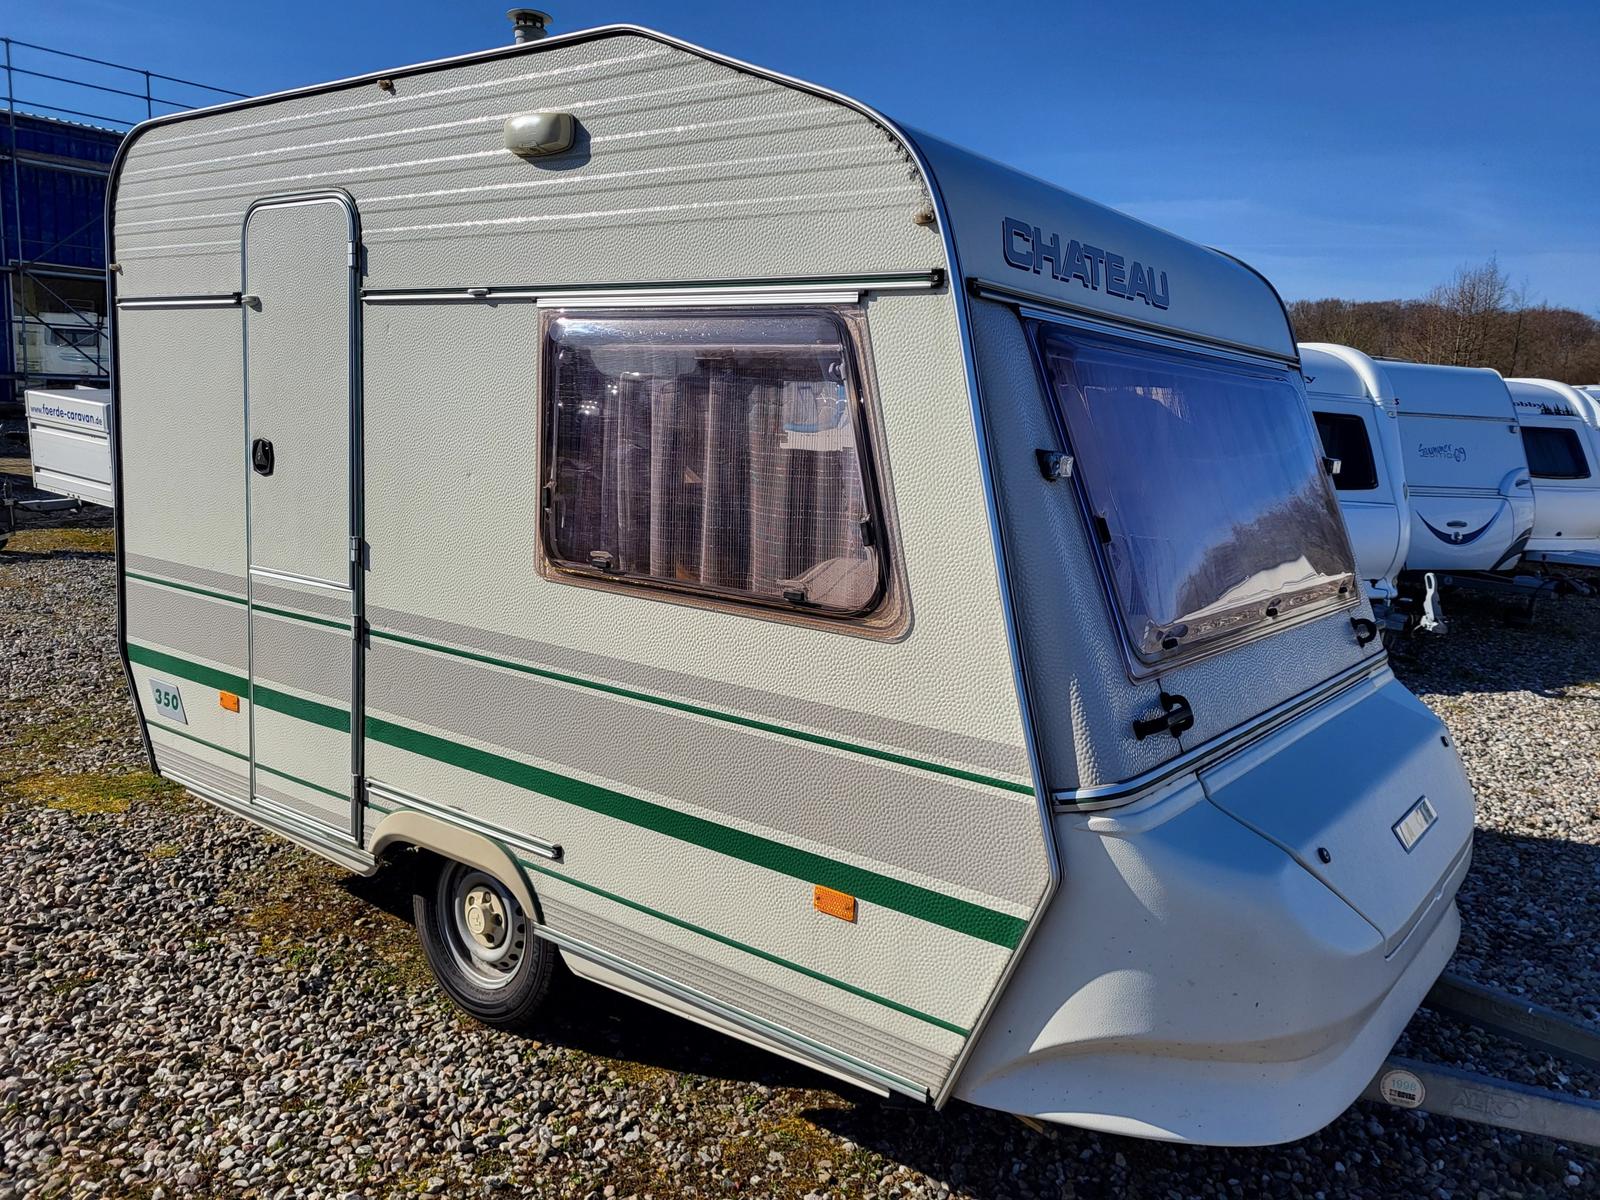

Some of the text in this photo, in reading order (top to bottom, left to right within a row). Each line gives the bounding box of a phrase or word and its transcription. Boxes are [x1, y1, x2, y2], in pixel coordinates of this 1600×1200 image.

[1002, 216, 1170, 311] CHATEAU
[30, 403, 103, 426] www.foerde-caravan.de
[155, 688, 179, 711] 350
